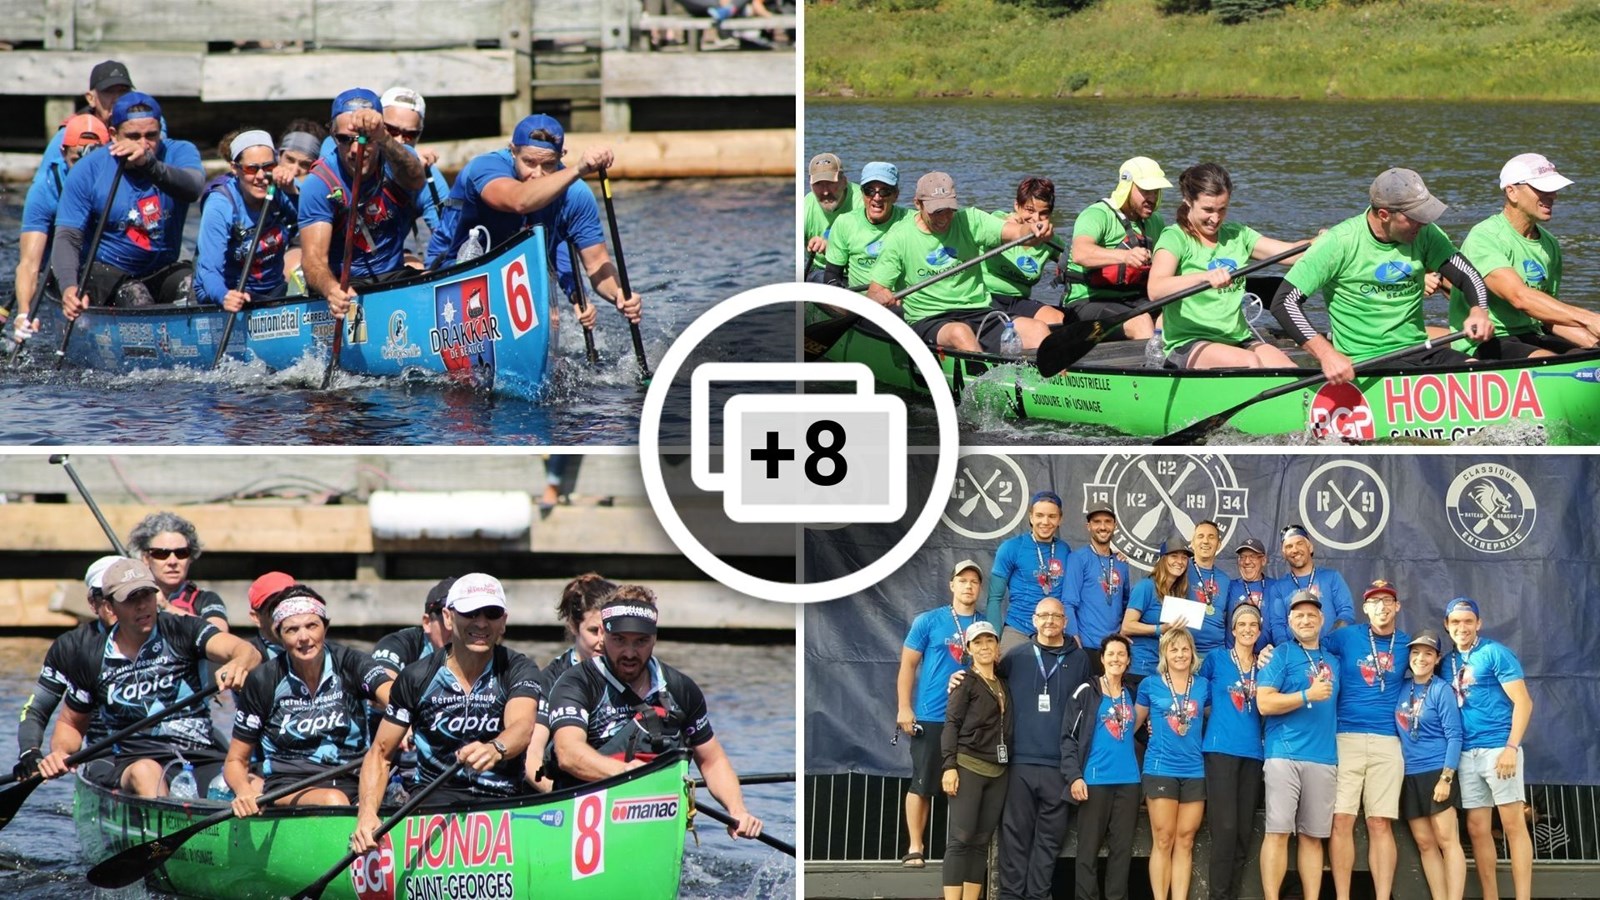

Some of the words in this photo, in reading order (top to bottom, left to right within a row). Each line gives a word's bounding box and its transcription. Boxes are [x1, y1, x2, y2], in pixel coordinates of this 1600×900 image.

[506, 261, 533, 332] 6
[430, 315, 502, 354] DRAKKAR
[450, 347, 459, 359] DE
[460, 344, 485, 356] BEAUCE
[1384, 369, 1546, 424] HONDA
[1157, 461, 1177, 475] C2
[1463, 466, 1518, 483] CLASSIQUE
[1126, 493, 1147, 507] K2
[1186, 494, 1206, 509] R9
[1222, 495, 1241, 510] 34
[1461, 531, 1523, 550] ENTREPRISE
[626, 802, 678, 820] manac
[404, 810, 514, 870] HONDA
[575, 795, 603, 875] 8
[406, 871, 514, 900] SAINT-GEORGES
